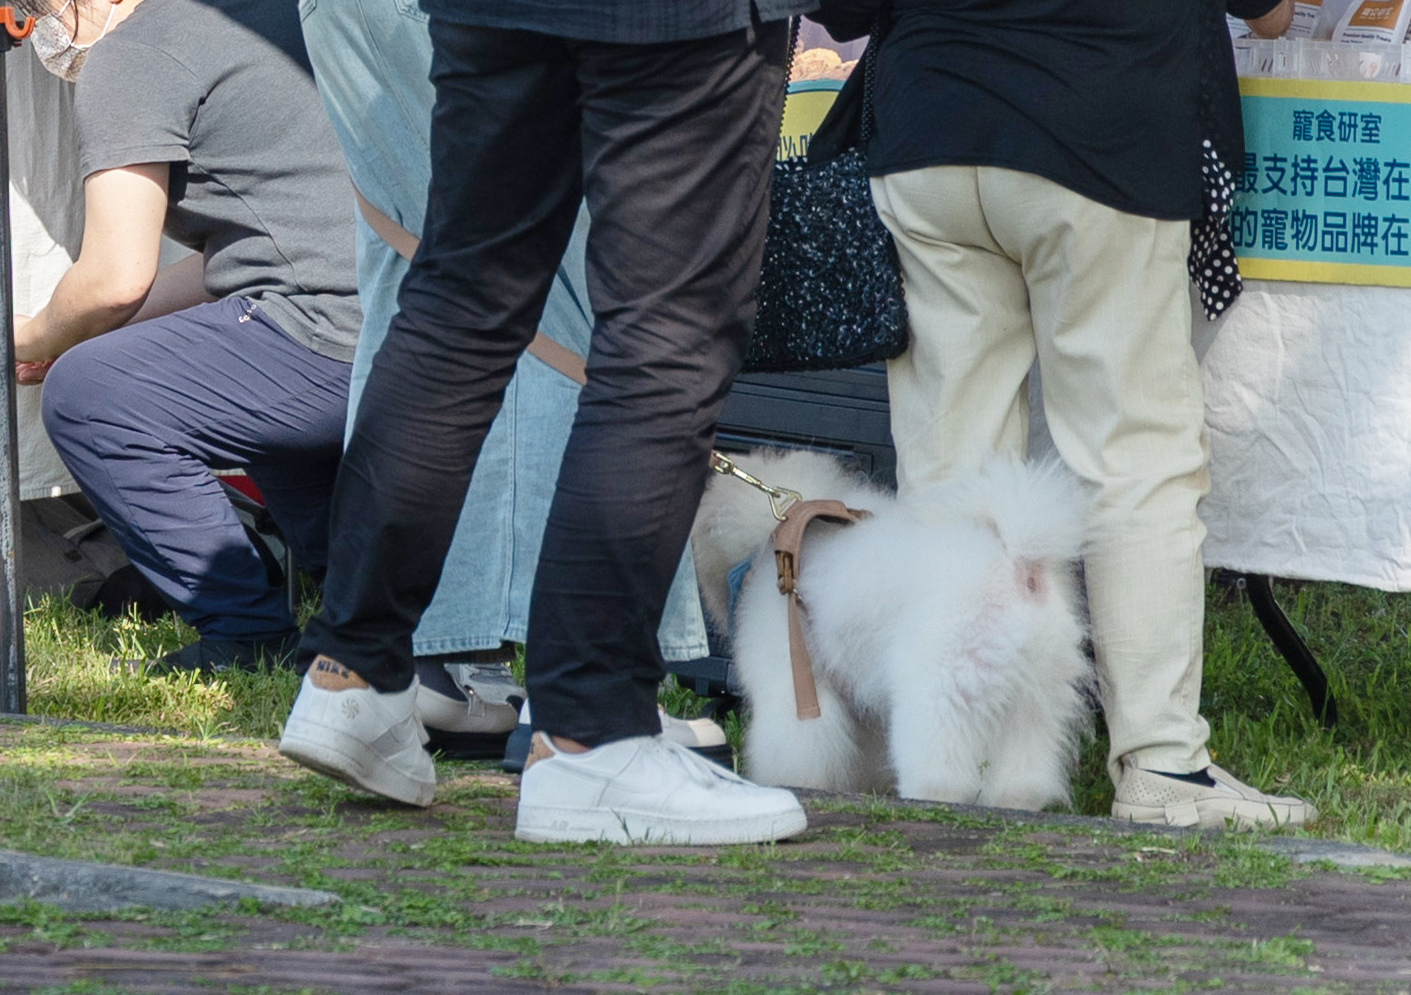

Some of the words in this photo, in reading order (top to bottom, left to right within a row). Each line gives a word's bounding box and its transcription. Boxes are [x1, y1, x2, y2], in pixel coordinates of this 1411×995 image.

[1292, 109, 1382, 144] 寵食研室
[1230, 206, 1411, 257] 的寵物品牌在
